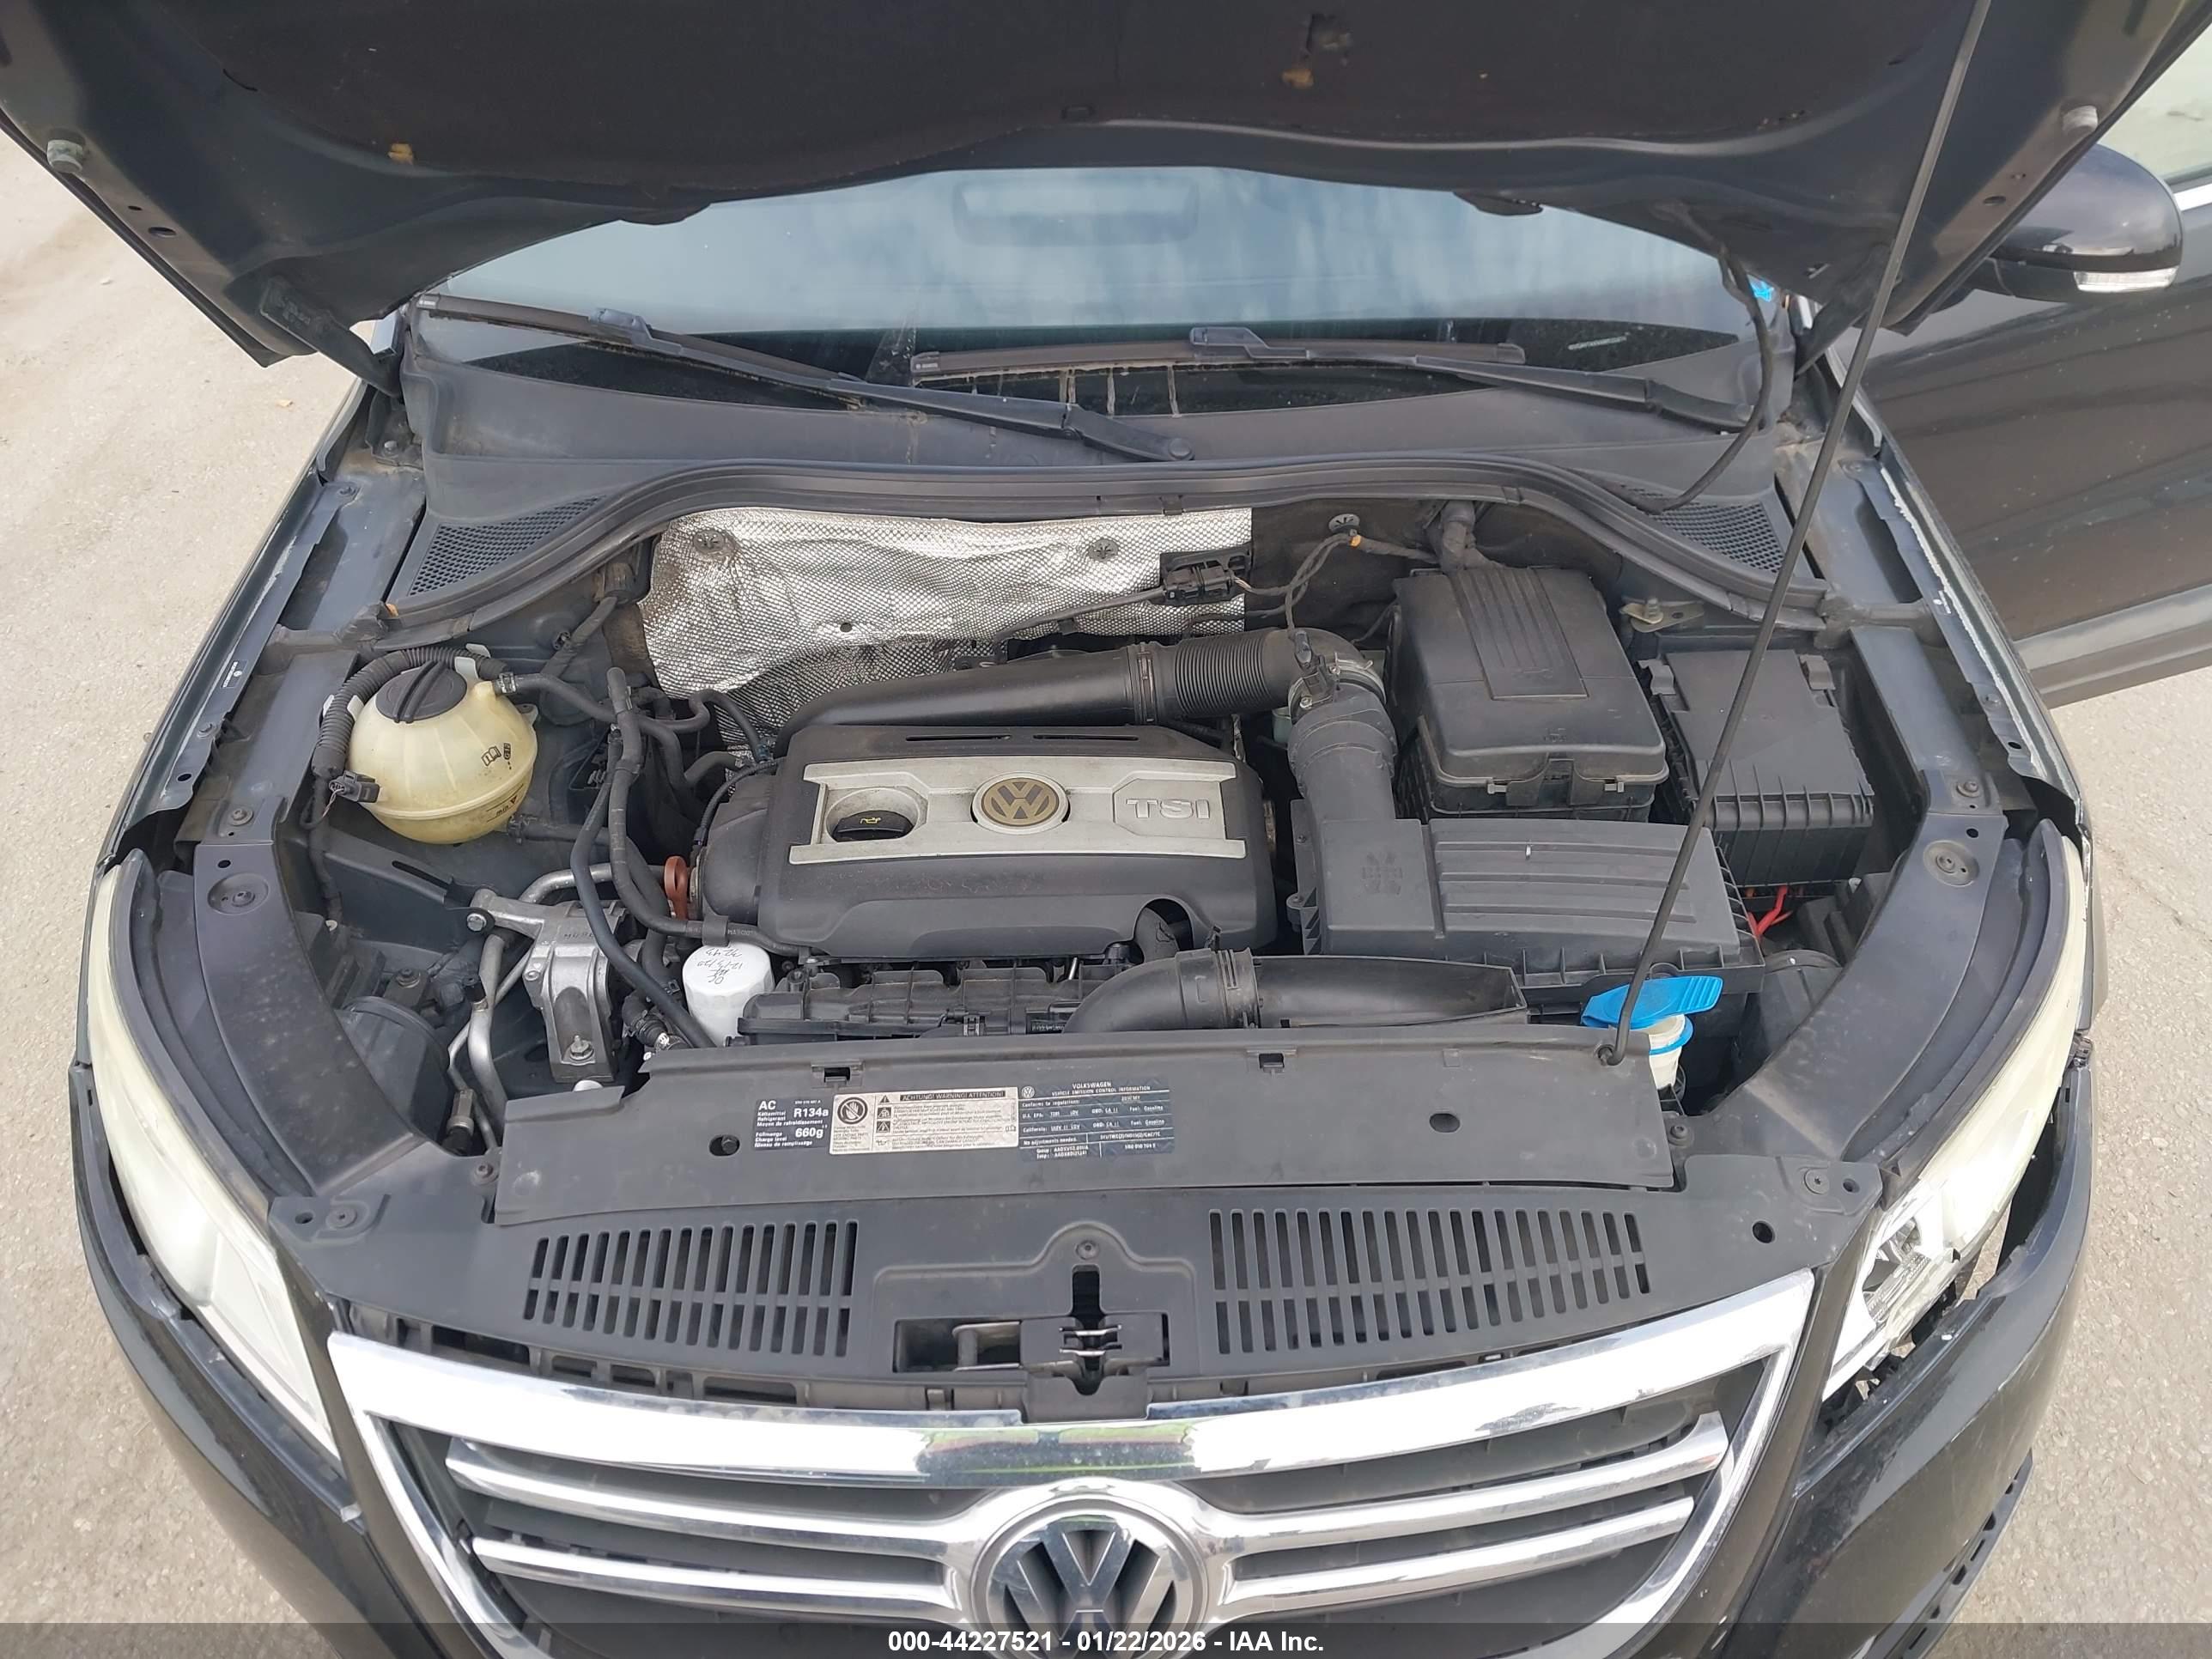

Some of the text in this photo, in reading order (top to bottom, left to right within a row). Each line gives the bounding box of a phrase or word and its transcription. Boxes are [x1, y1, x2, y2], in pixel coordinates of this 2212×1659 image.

[496, 805, 509, 816] min
[1126, 799, 1211, 819] TSI
[1072, 1081, 1112, 1090] VOLKSWAGEN
[936, 1091, 968, 1100] WARNING!
[969, 1091, 1004, 1099] ATTENTION!
[758, 1100, 776, 1110] AC
[793, 1107, 829, 1118] R134a
[795, 1127, 824, 1139] 660g
